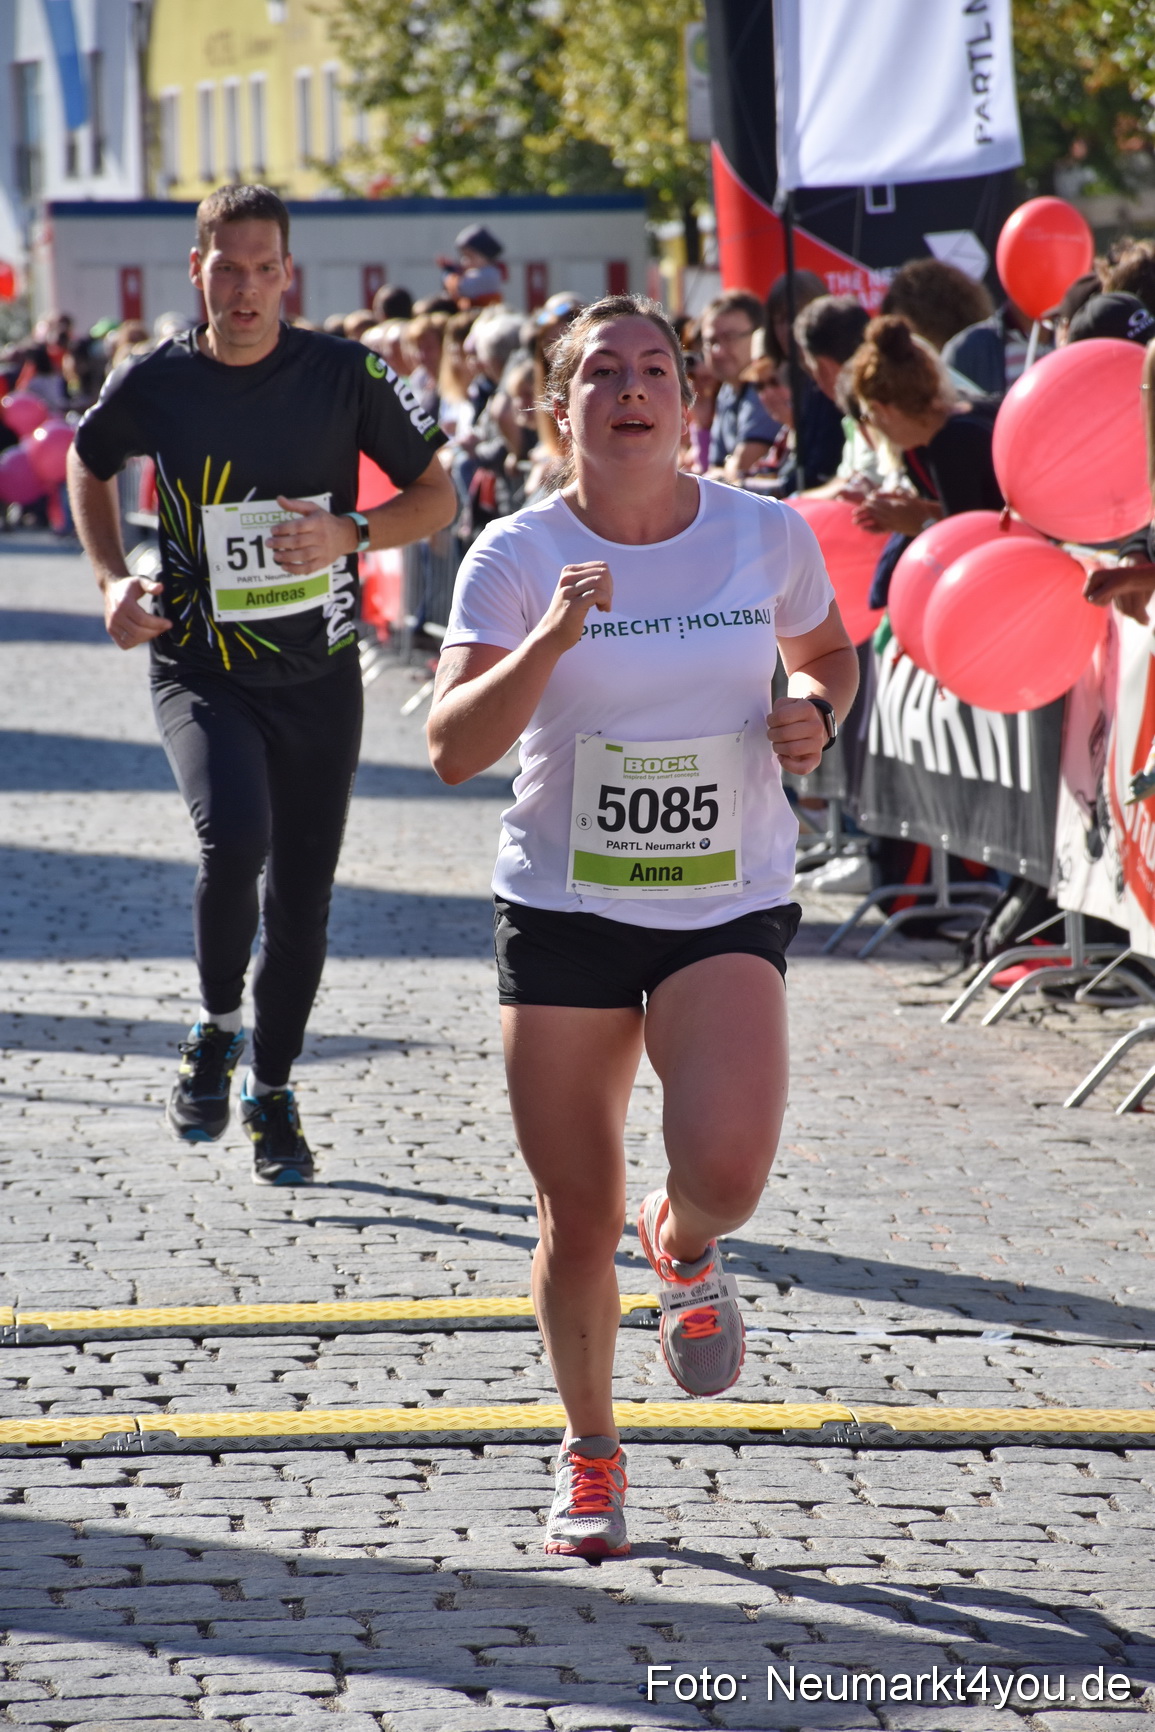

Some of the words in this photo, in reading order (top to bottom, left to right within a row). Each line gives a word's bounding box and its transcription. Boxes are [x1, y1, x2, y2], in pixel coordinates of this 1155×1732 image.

[965, 21, 993, 146] PARTL
[226, 534, 284, 571] 51
[236, 575, 263, 584] PARTL
[265, 573, 299, 582] Neumar
[245, 587, 306, 606] Andreas
[687, 608, 771, 631] HOLZBAU
[624, 755, 698, 773] BOCK
[597, 783, 719, 834] 5085
[581, 817, 587, 827] S
[606, 840, 643, 851] PARTL
[645, 840, 696, 851] Neumarkt
[629, 863, 683, 881] Anna
